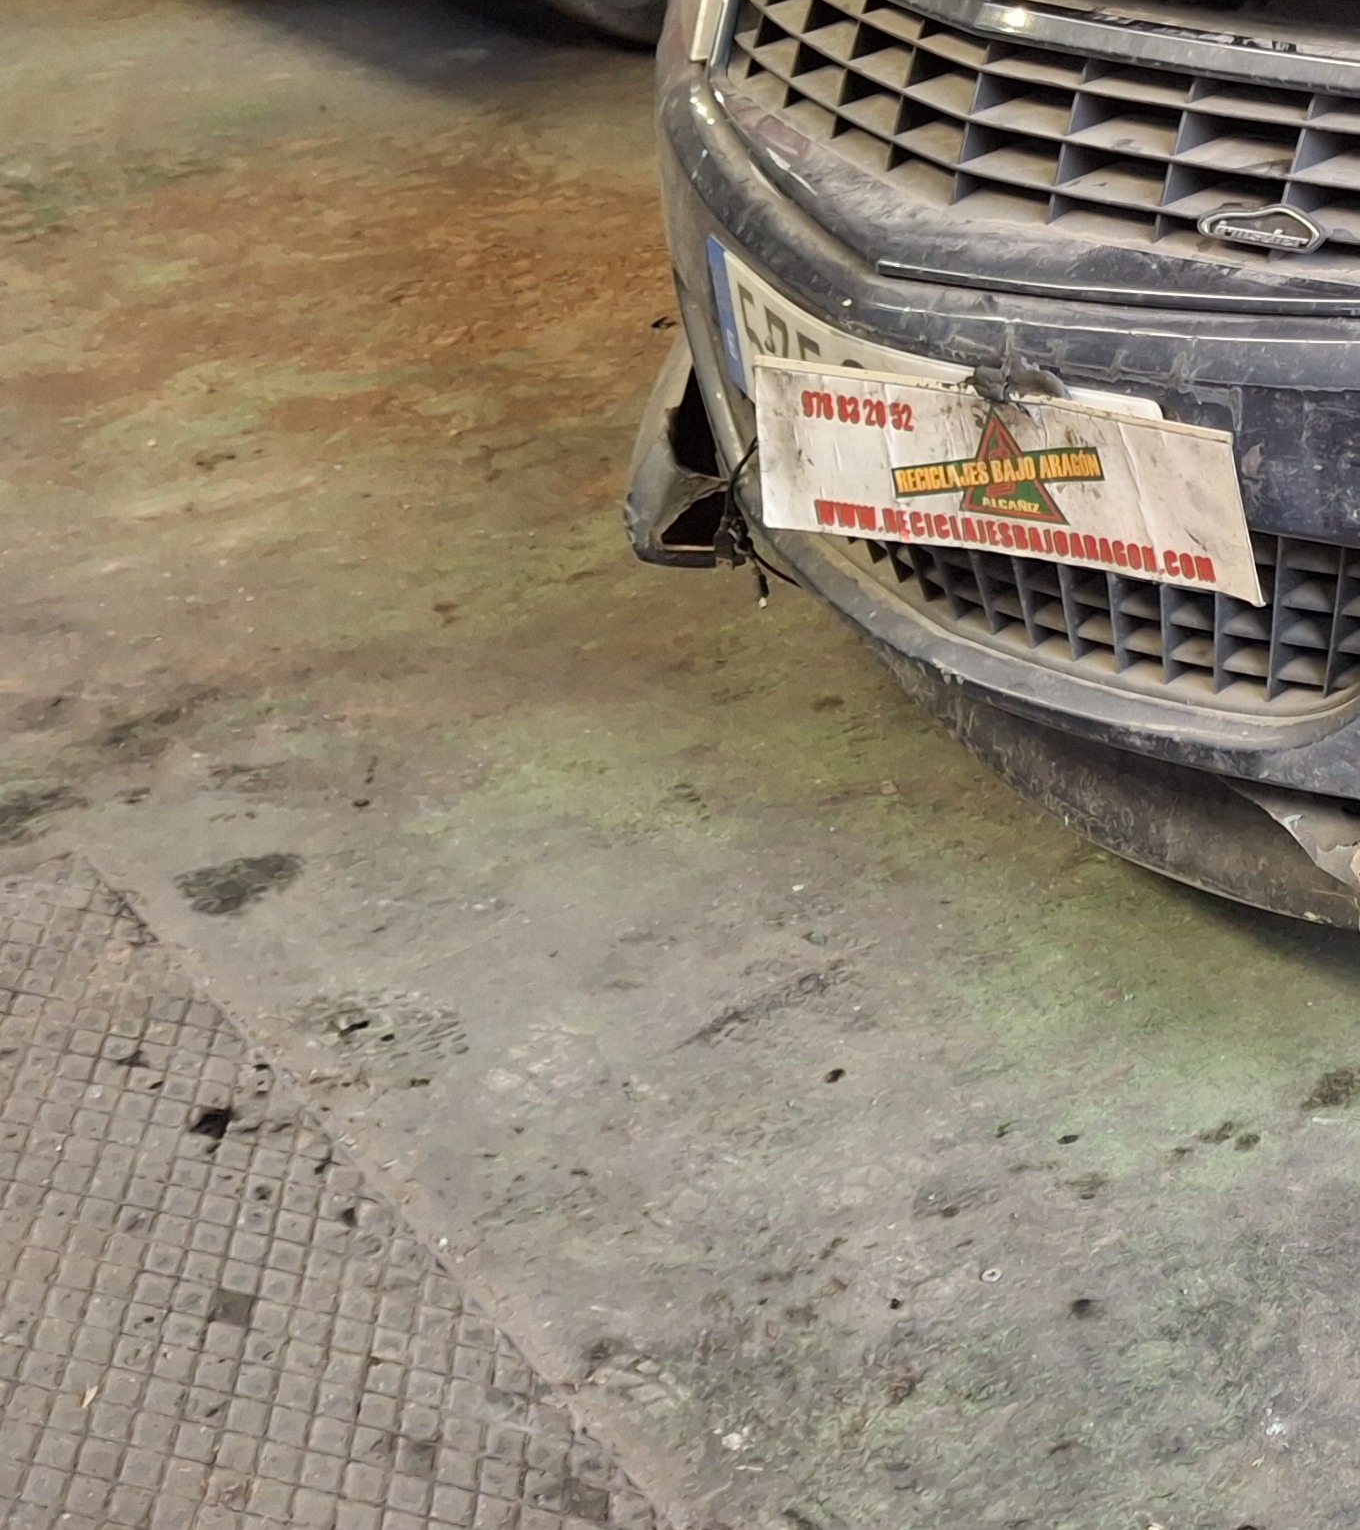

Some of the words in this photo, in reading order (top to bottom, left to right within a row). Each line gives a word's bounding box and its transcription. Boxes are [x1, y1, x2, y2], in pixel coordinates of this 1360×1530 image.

[801, 390, 833, 420] 978
[836, 395, 861, 423] 83
[863, 398, 887, 427] 20
[890, 403, 915, 431] 52
[894, 460, 989, 493] RECICLAJES
[989, 456, 1037, 484] BAJO
[1039, 449, 1102, 479] ARAGÓN
[981, 496, 1042, 514] ALCAÑIZ
